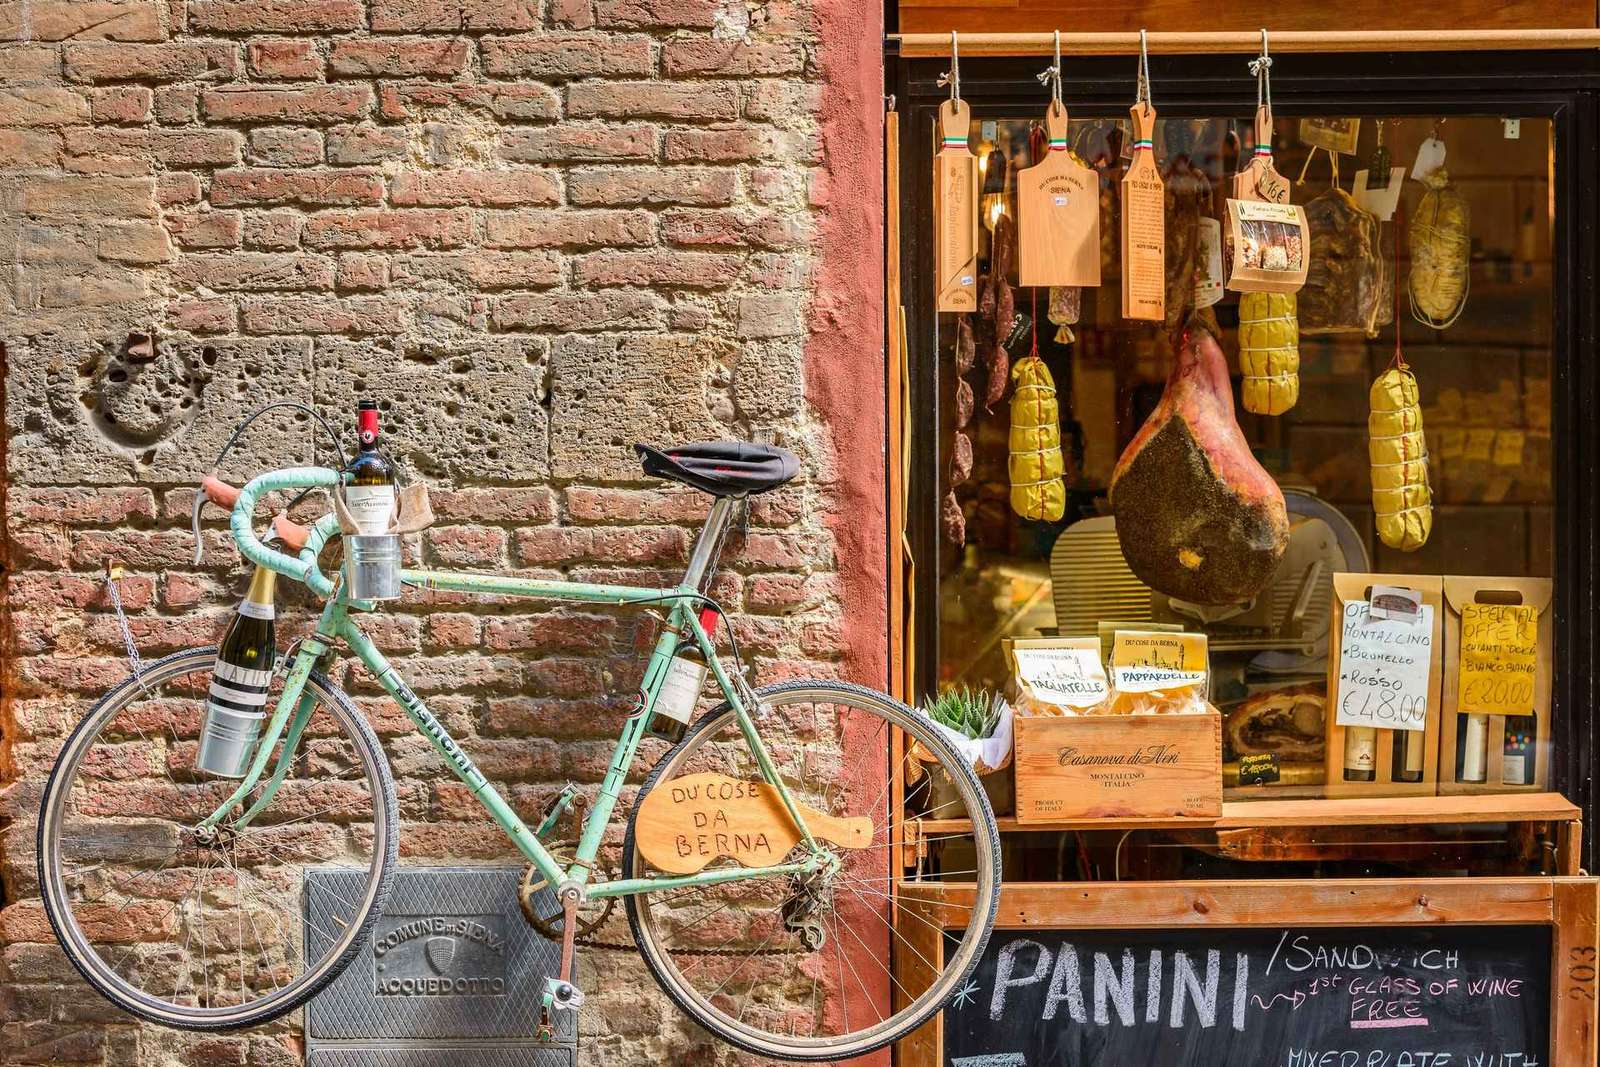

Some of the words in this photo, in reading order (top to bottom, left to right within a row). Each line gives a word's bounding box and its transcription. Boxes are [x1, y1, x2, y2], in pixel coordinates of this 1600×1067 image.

[1343, 622, 1431, 646] MONTALCINO
[1463, 622, 1531, 640] OFFER
[1350, 644, 1414, 665] BRUNELLO
[1030, 680, 1104, 694] TAGLIATELLE
[1122, 672, 1200, 682] PAPPARDELLE
[1351, 669, 1403, 691] ROSSO
[1342, 689, 1426, 723] €48,00
[1057, 746, 1125, 767] Casanova
[1126, 747, 1142, 765] di
[1140, 743, 1181, 765] Neri
[1089, 771, 1145, 780] MONTALCINO
[706, 782, 761, 800] COSE
[693, 809, 729, 828] DA
[675, 832, 772, 858] BERNA
[375, 916, 446, 954] COMUNE
[377, 976, 505, 995] ACQUEDOTTO
[989, 938, 1249, 1032] PANINI
[1309, 973, 1343, 996] 1st
[1348, 976, 1421, 996] GLASS
[1428, 978, 1459, 995] OF
[1467, 978, 1523, 997] WINE
[1350, 998, 1423, 1021] FREE
